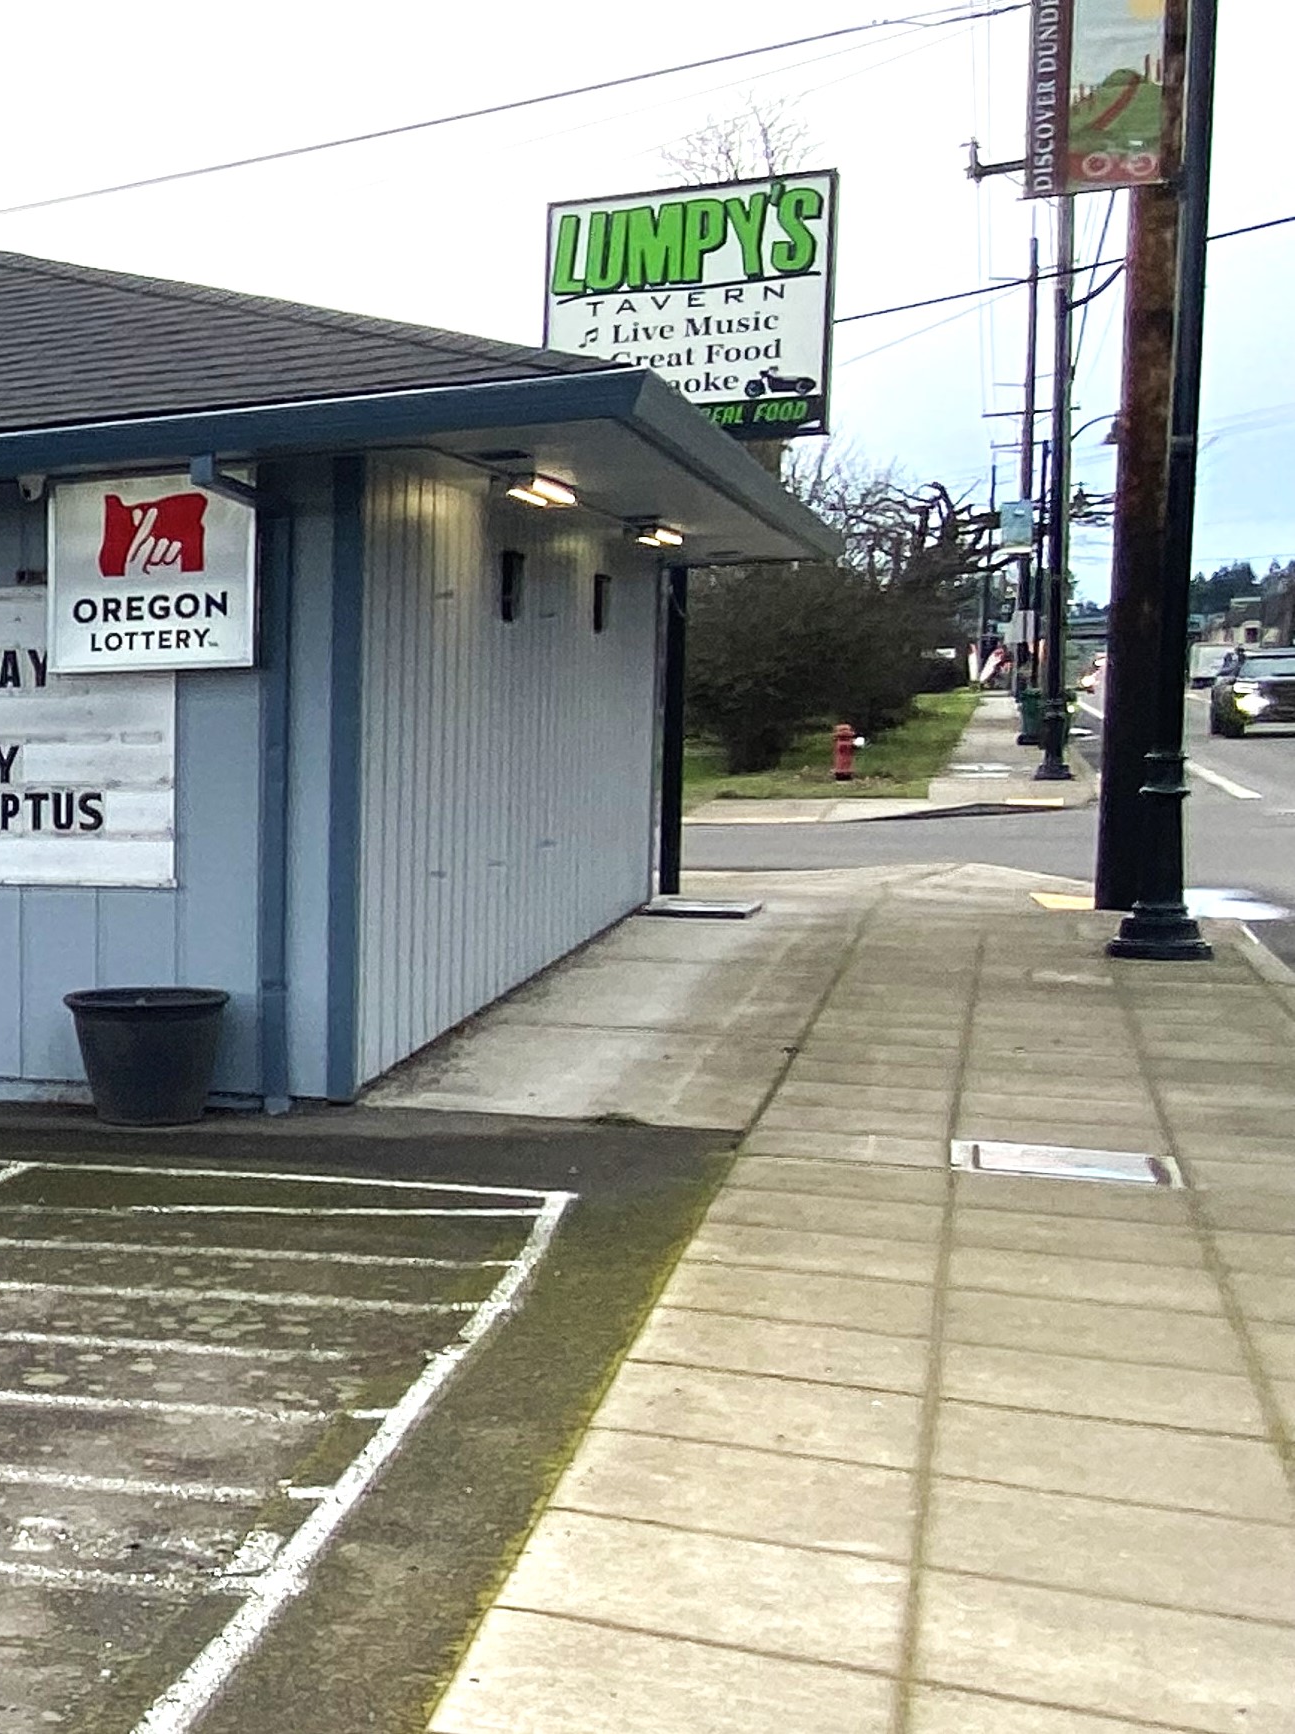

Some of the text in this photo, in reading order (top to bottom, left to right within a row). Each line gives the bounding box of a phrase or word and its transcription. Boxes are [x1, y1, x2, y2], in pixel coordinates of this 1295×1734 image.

[1033, 79, 1056, 191] DISCOVER
[552, 180, 824, 295] LUMPY'S
[586, 284, 785, 317] TAVERN
[612, 310, 780, 344] Live Music
[705, 338, 782, 364] Food
[753, 400, 808, 422] FOOD
[73, 591, 228, 623] OREGON
[91, 628, 211, 652] LOTTERY
